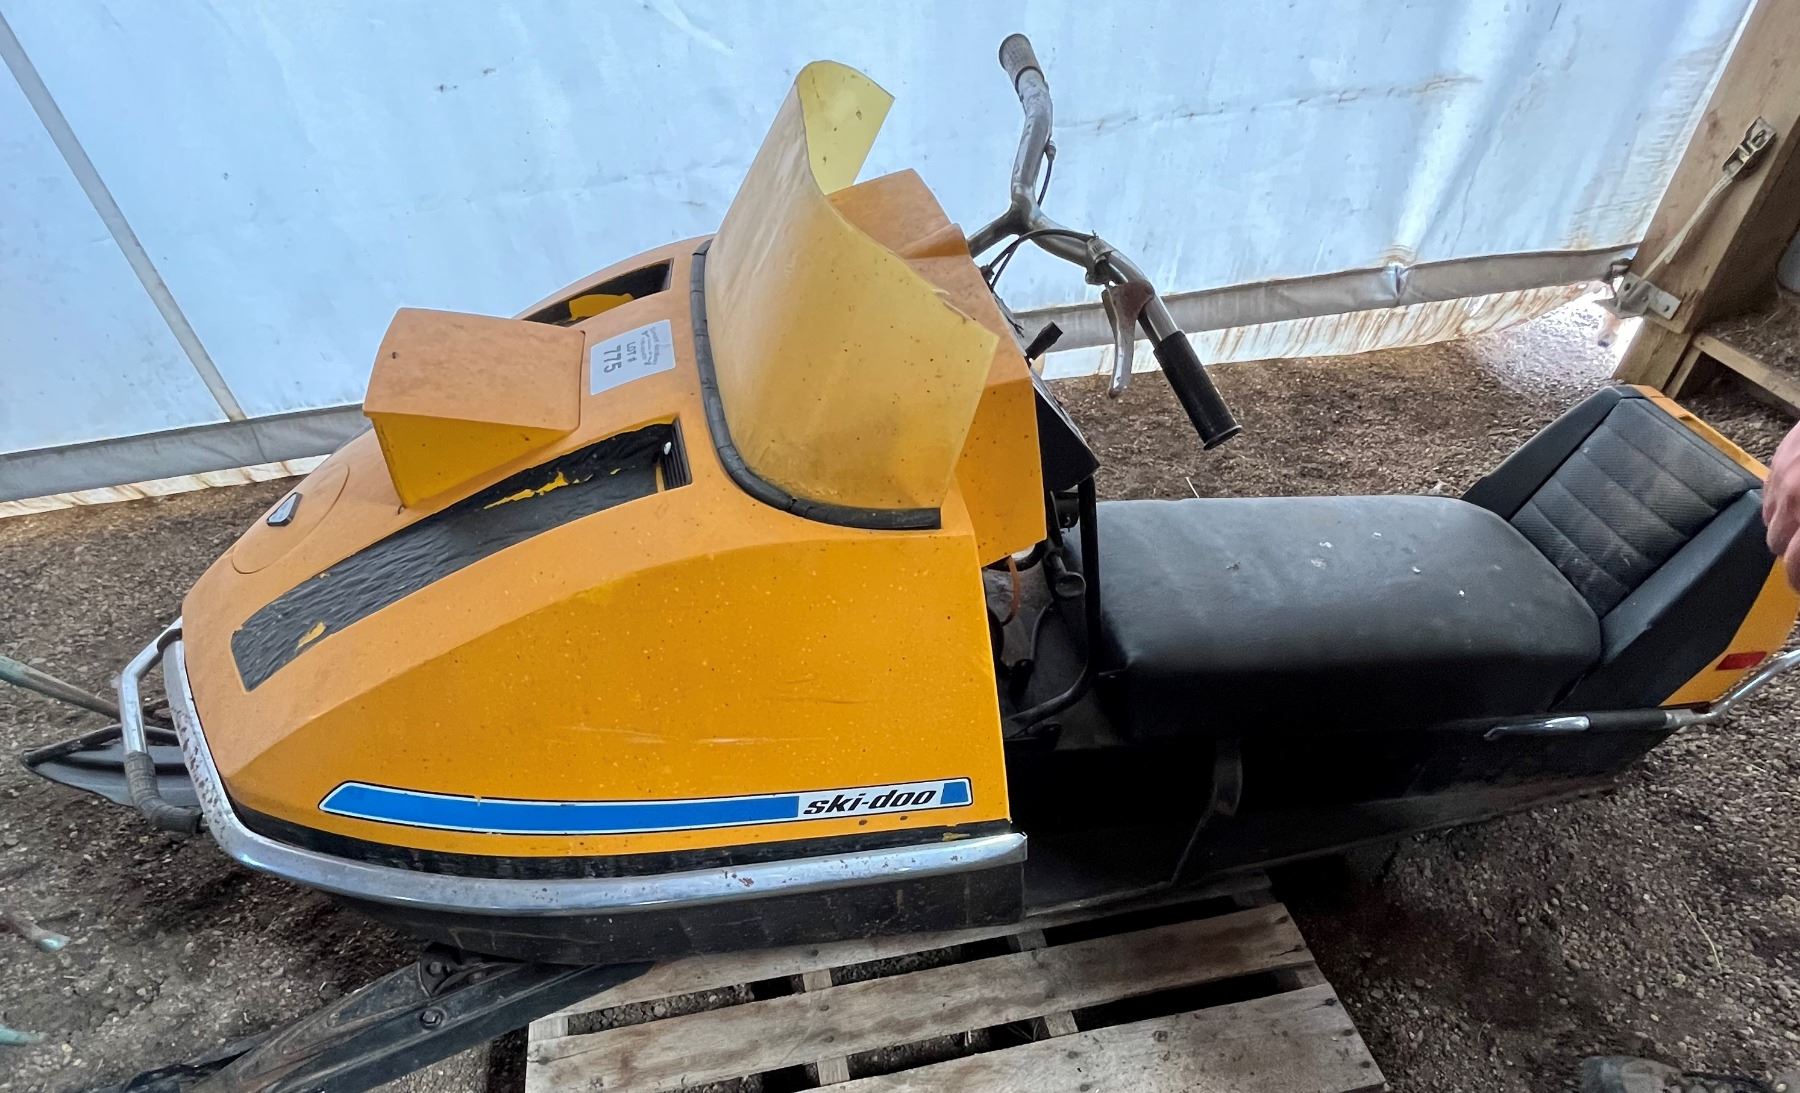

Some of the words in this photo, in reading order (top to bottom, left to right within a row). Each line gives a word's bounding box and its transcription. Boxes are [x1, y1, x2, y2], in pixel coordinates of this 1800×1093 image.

[603, 344, 622, 374] 775
[626, 341, 637, 356] LOT
[803, 790, 938, 815] ski-doo
